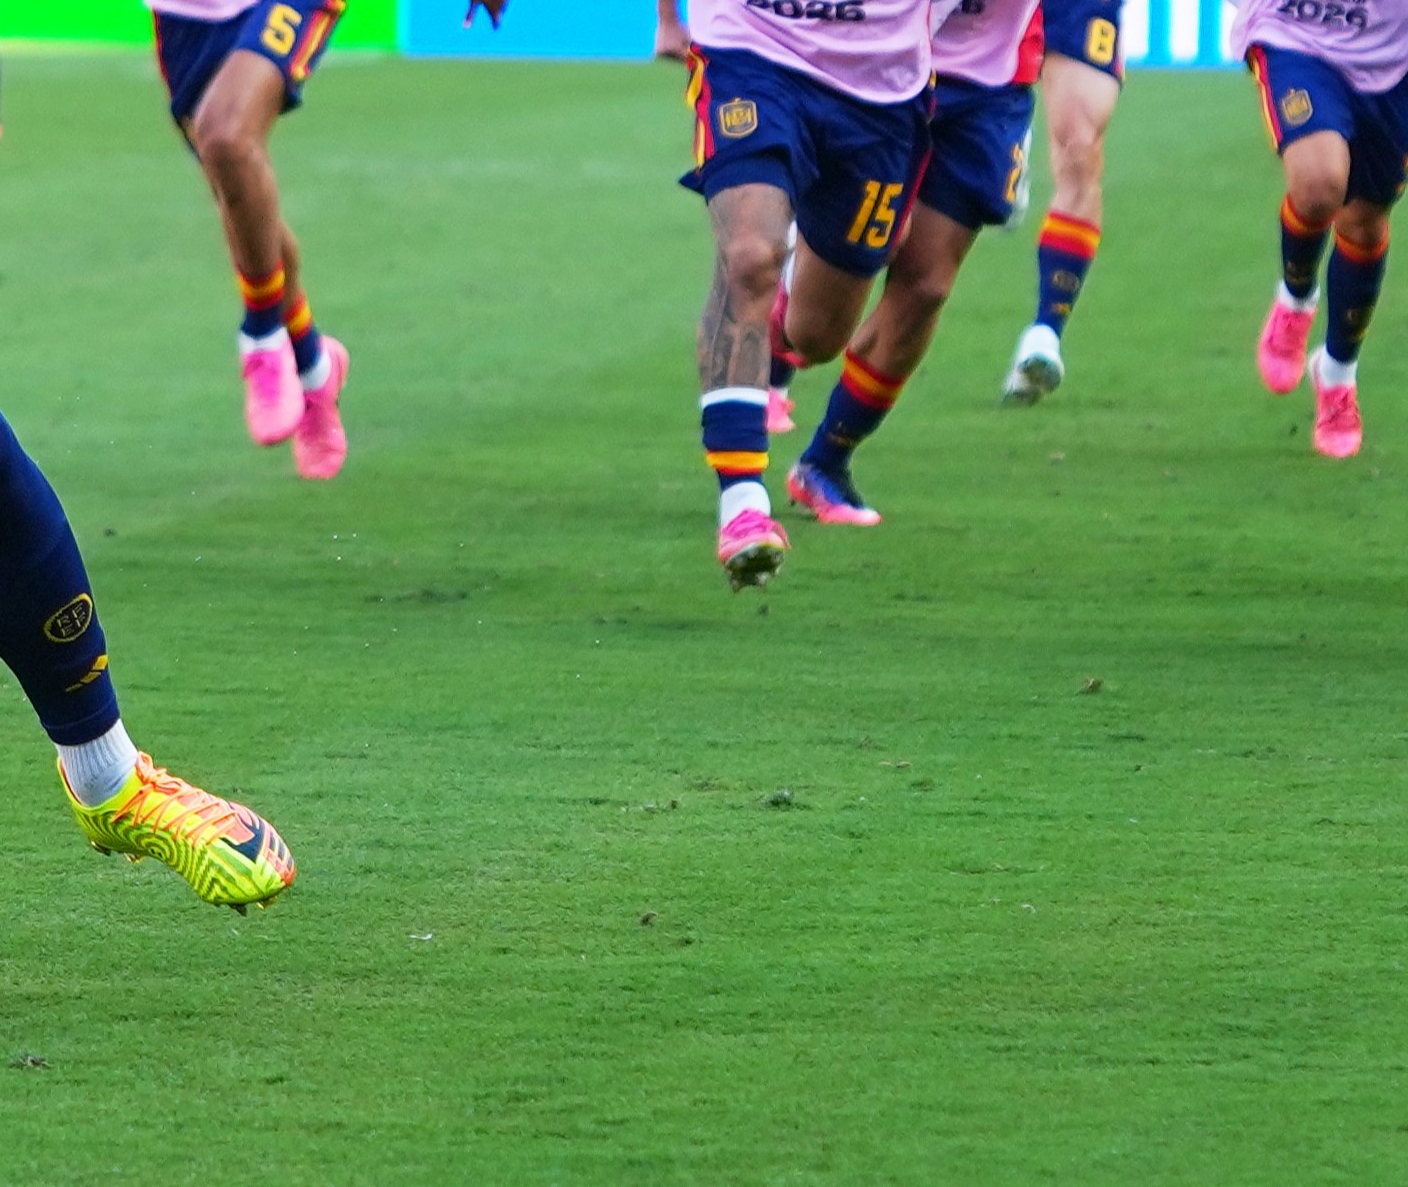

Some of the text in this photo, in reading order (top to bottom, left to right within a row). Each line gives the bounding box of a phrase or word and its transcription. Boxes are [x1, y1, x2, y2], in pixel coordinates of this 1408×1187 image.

[261, 2, 302, 57] 5
[1086, 17, 1117, 65] 8
[847, 180, 903, 248] 15
